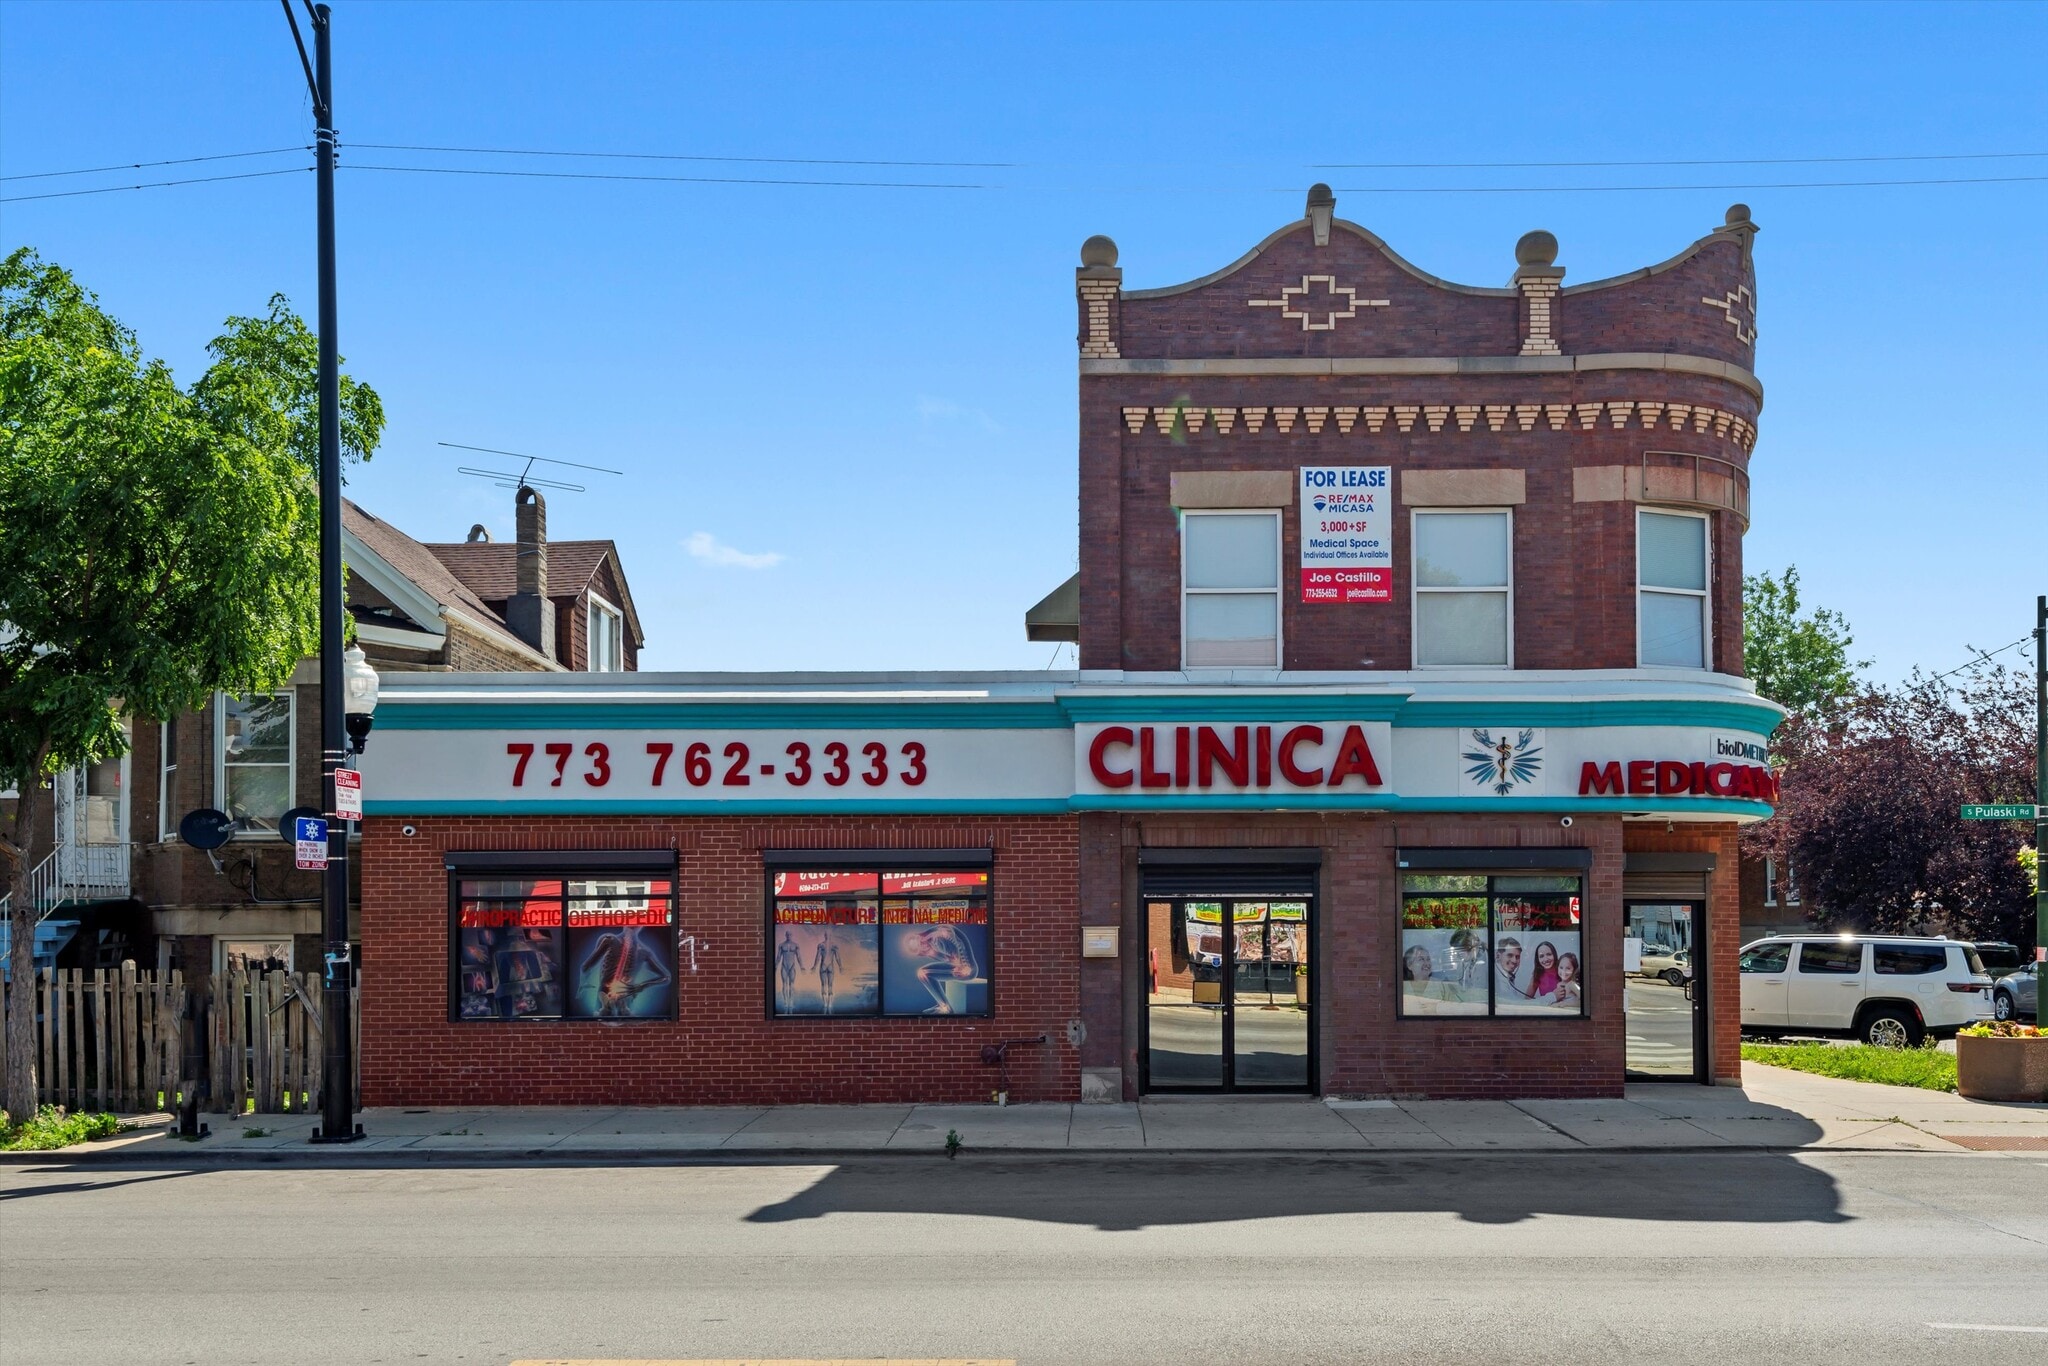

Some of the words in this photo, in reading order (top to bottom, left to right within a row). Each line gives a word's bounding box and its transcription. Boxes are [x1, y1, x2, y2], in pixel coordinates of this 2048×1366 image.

[1306, 470, 1336, 487] FOR
[1342, 470, 1386, 486] LEASE
[1328, 494, 1374, 503] RE/MAX
[1328, 504, 1374, 512] MICASA
[1310, 539, 1347, 548] Medical
[1350, 539, 1379, 550] Space
[1310, 573, 1332, 582] Joe
[1336, 573, 1381, 582] Castillo
[507, 742, 611, 787] 773
[646, 742, 927, 787] 762-3333
[1088, 725, 1383, 789] CLINICA
[1975, 807, 2016, 817] Pulaski
[457, 909, 562, 926] CHIROPRACTIC
[569, 909, 672, 926] ORTHOPEDIC
[774, 907, 877, 924] ACUPUNCTURE
[884, 908, 935, 924] INTERNAL
[1429, 904, 1479, 915] VILLITA
